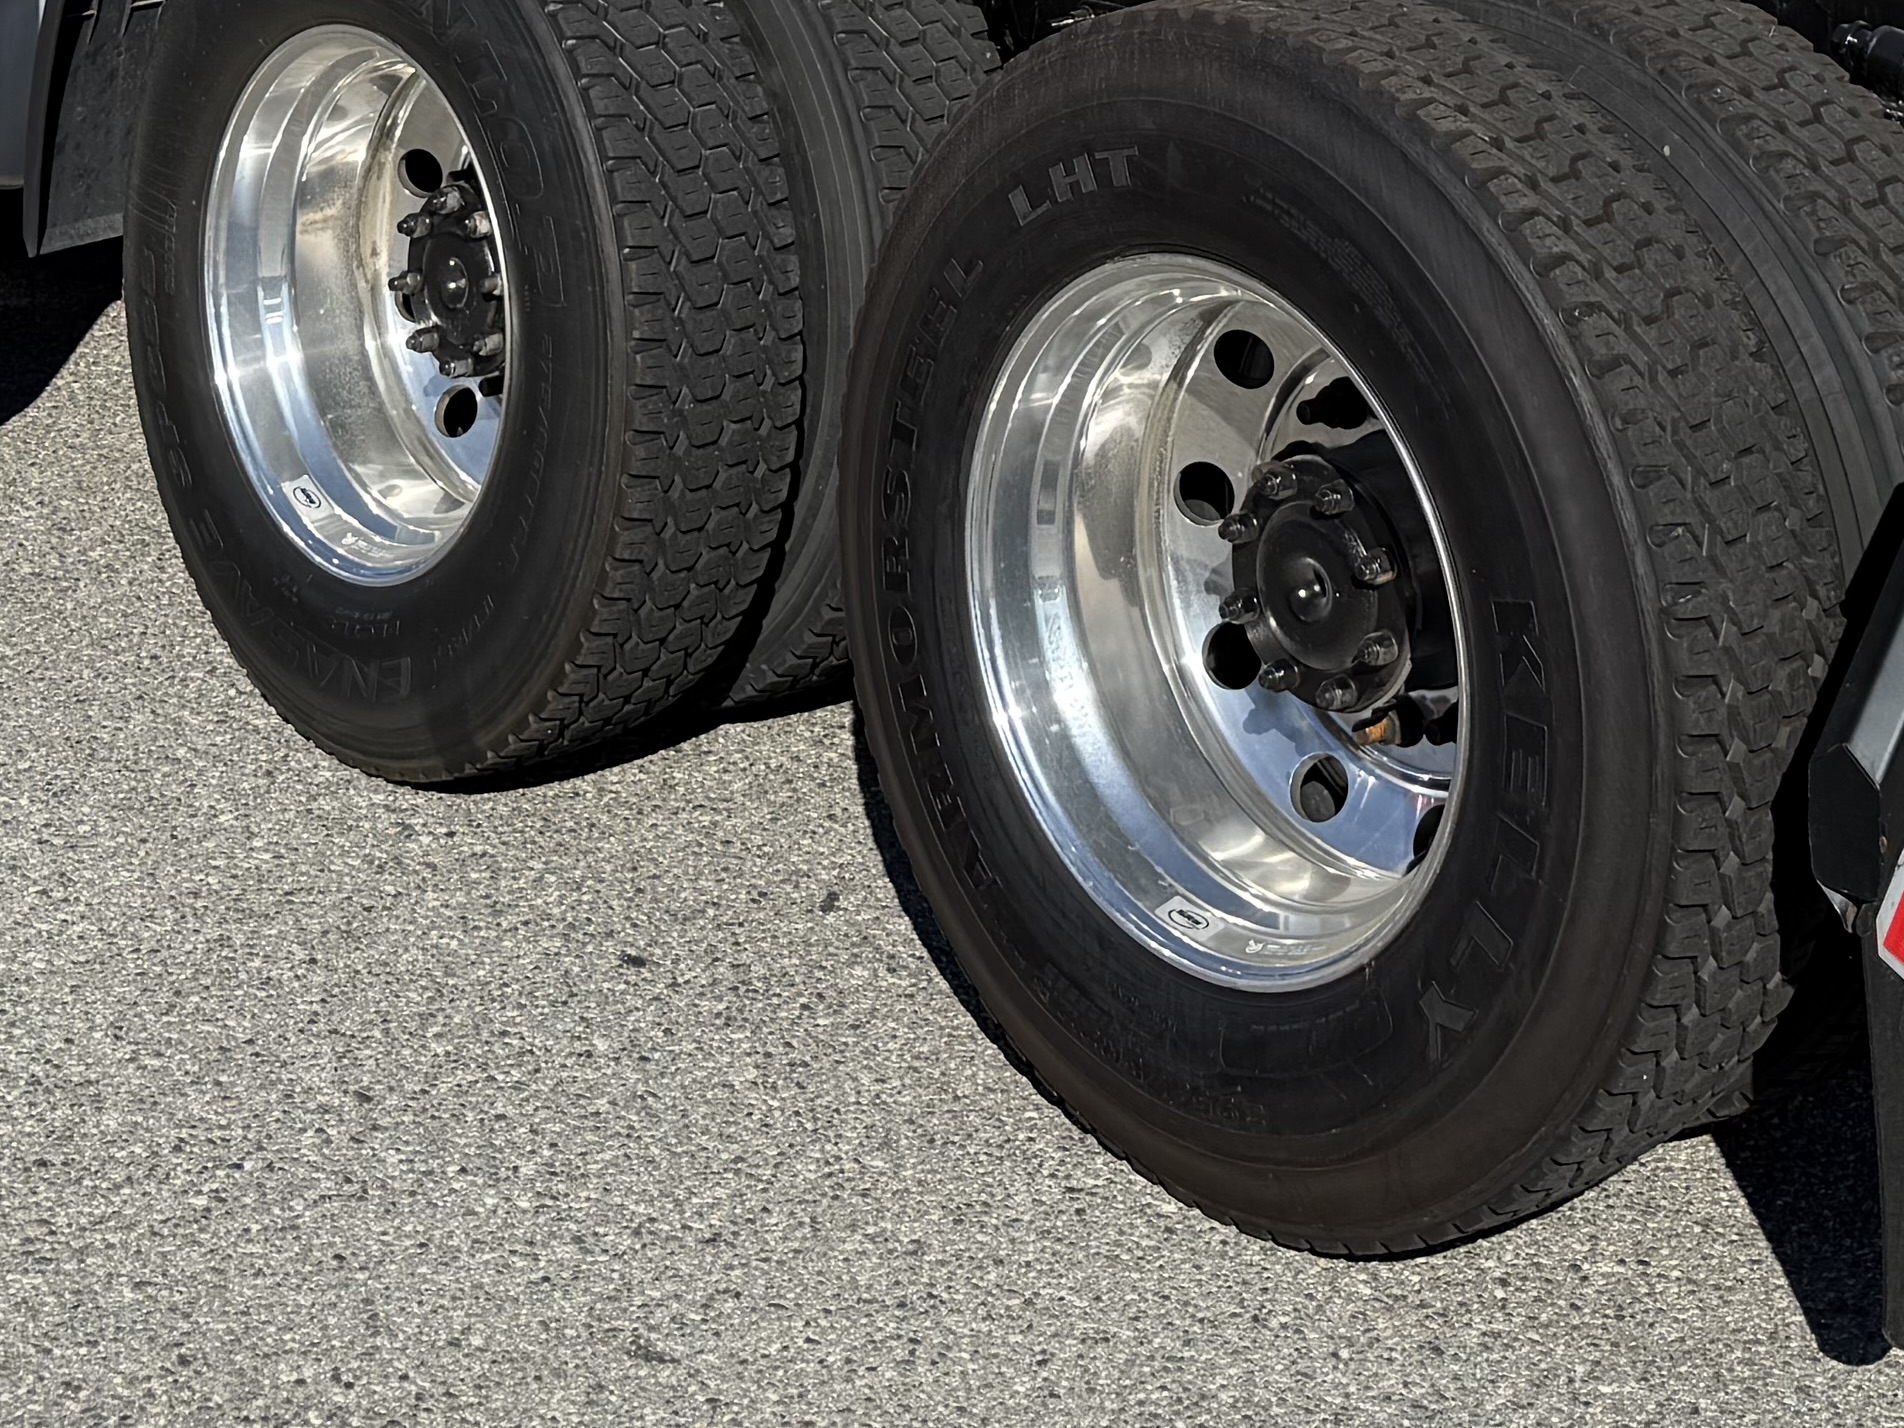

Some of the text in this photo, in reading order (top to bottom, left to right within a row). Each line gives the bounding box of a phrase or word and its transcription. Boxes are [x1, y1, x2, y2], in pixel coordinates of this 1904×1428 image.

[1007, 146, 1142, 227] LHT
[879, 252, 1004, 892] ARMORSTEEL
[1418, 599, 1551, 1066] KELLY
